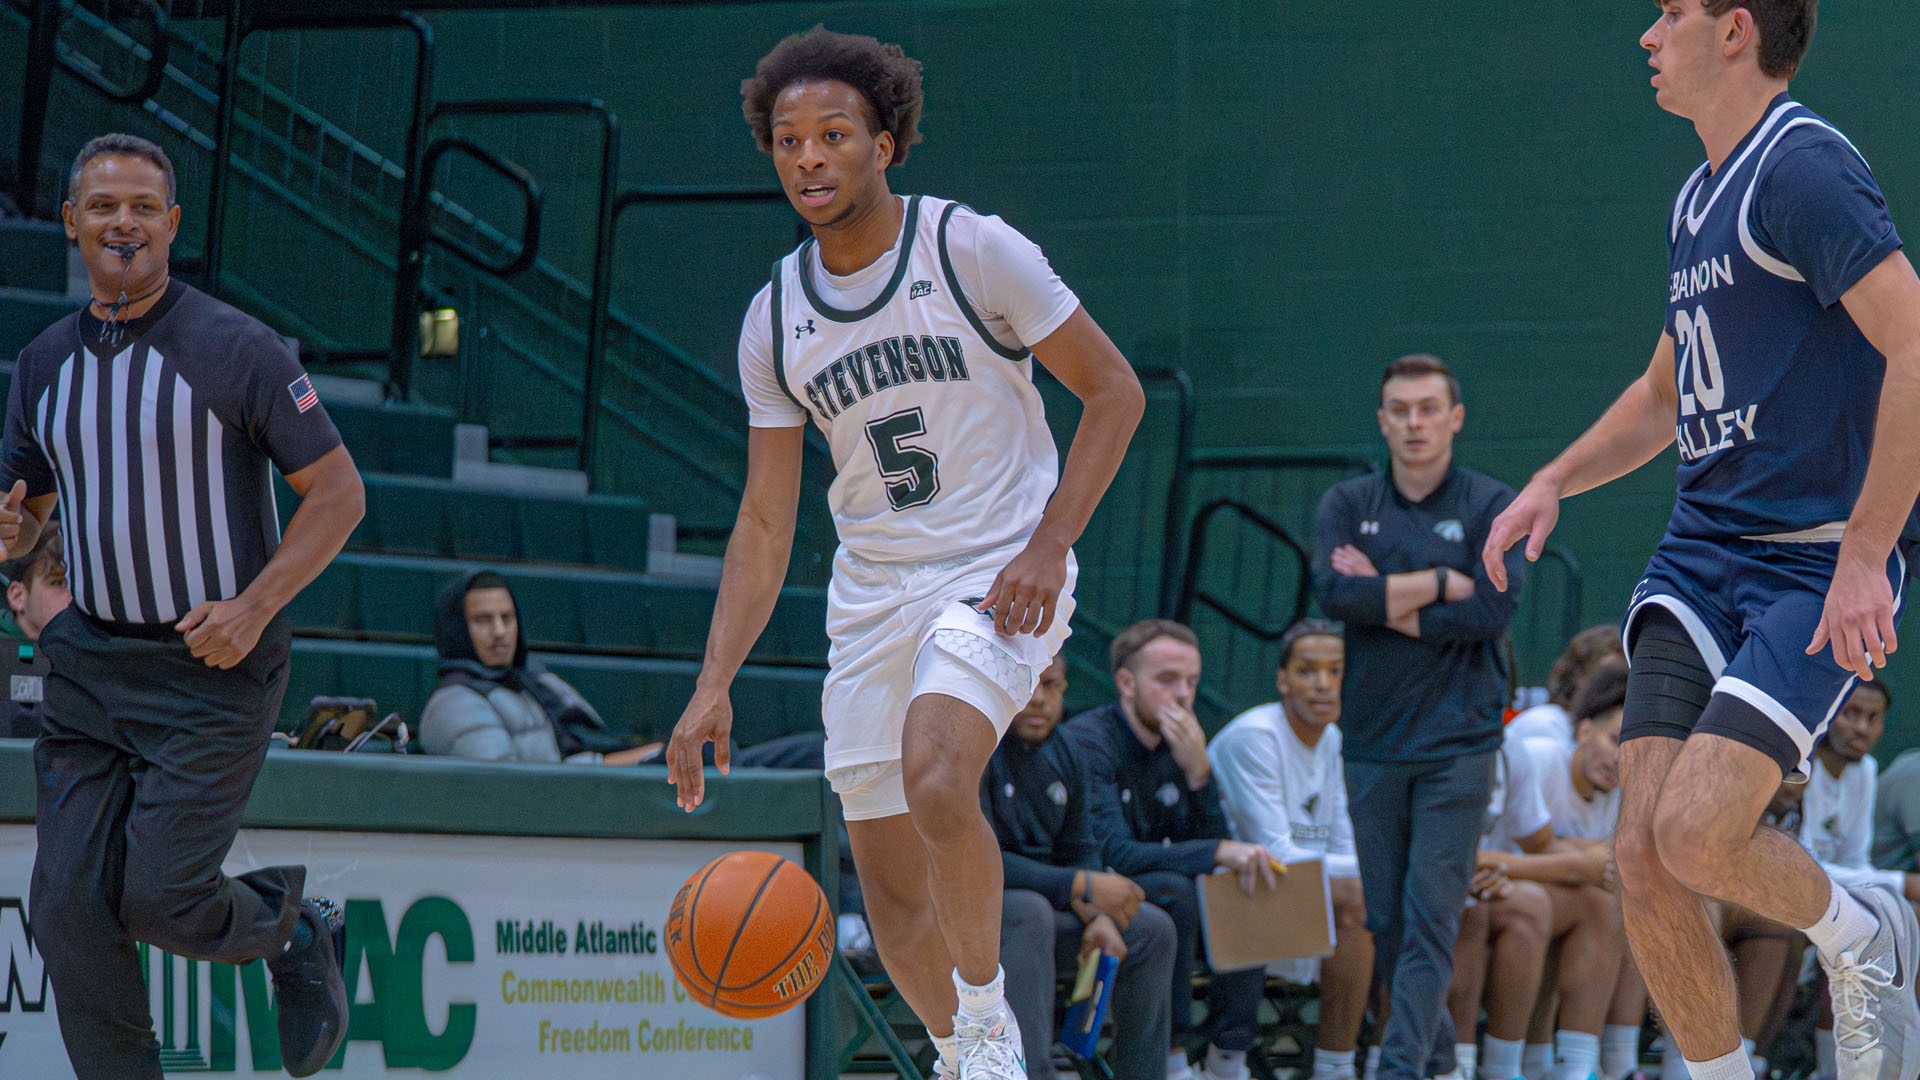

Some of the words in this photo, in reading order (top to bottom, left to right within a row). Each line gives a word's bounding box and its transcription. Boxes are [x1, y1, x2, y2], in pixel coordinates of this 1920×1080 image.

[1669, 253, 1734, 304] BANON
[804, 335, 970, 422] STEVENSON
[1674, 304, 1725, 416] 20
[1676, 404, 1758, 462] ALLEY
[864, 406, 941, 512] 5
[496, 918, 568, 956] Middle
[574, 919, 658, 956] Atlantic
[501, 969, 666, 1005] Commonwealth
[773, 949, 820, 999] THE
[538, 1018, 631, 1054] Freedom
[637, 1017, 754, 1054] Conference
